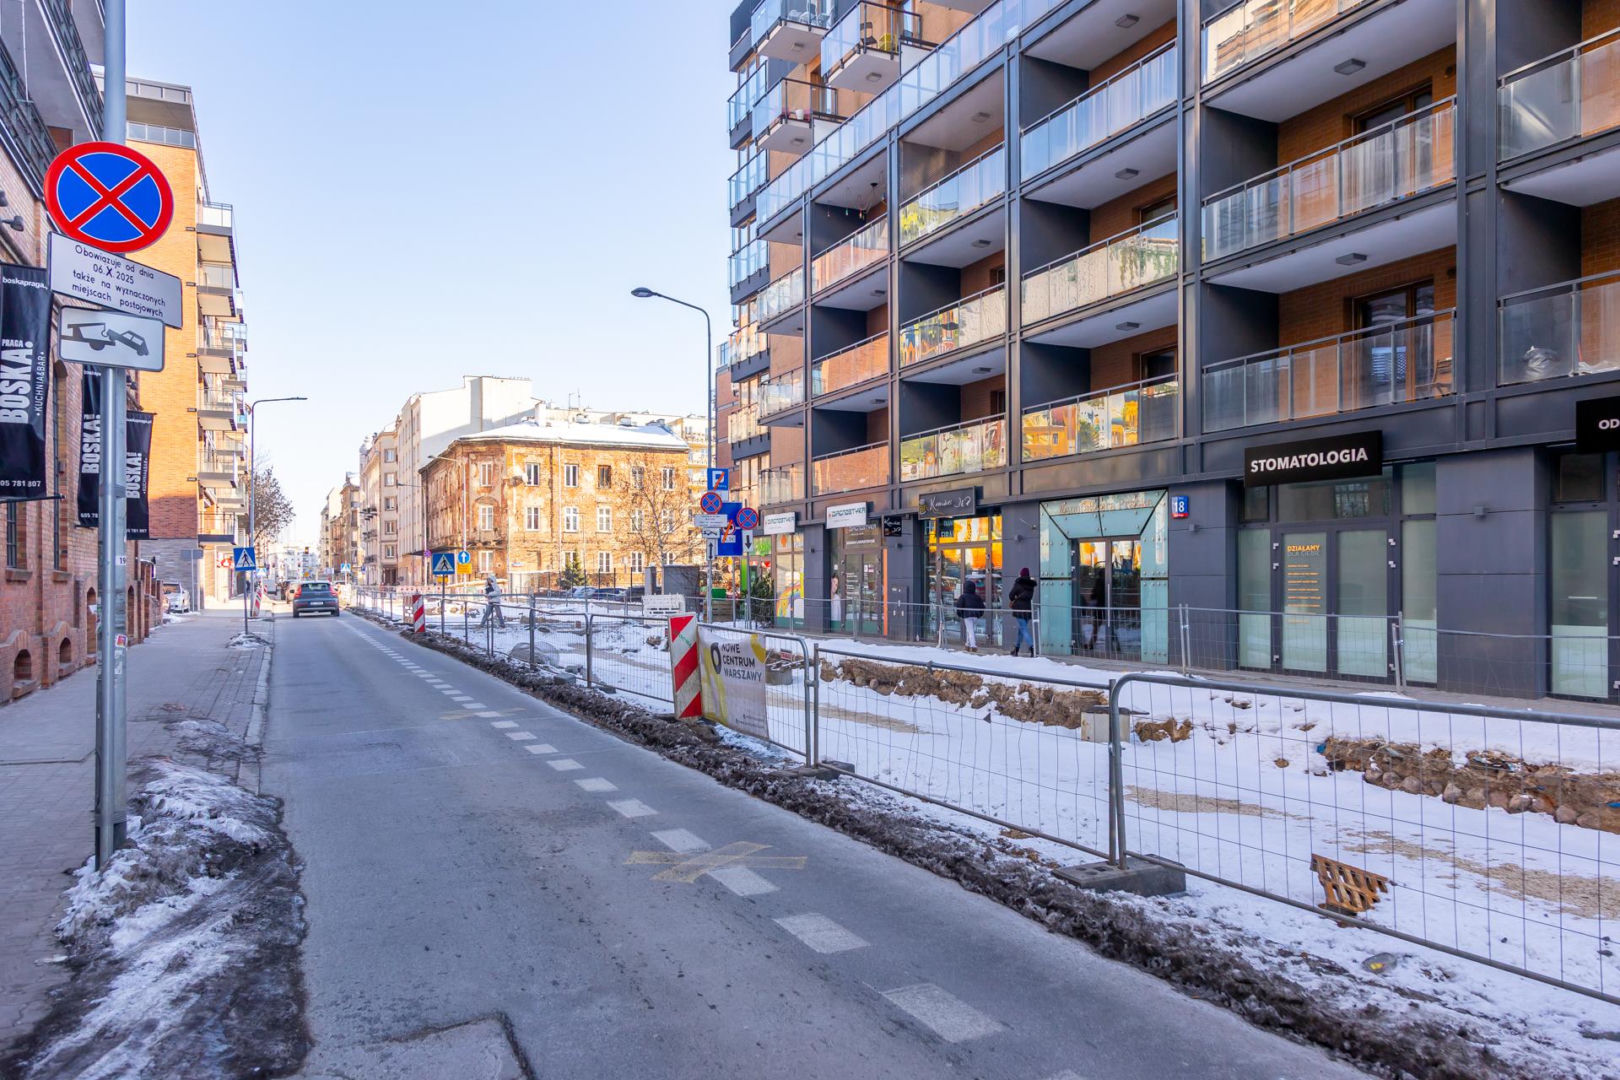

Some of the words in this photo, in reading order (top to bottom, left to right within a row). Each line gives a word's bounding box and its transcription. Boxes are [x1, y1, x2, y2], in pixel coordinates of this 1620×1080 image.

[125, 263, 135, 273] od
[138, 268, 154, 279] dnia
[73, 269, 95, 284] także
[101, 280, 111, 289] na
[115, 284, 166, 307] wyznaczonych
[72, 283, 112, 302] miejscach
[120, 298, 163, 317] postojowych
[2, 338, 24, 348] PRAGA
[1250, 447, 1368, 473] STOMATOLOGIA
[1174, 501, 1185, 513] 18
[721, 643, 740, 654] NOWE
[722, 655, 755, 668] CENTRUM
[724, 666, 762, 682] WARSZAWY
